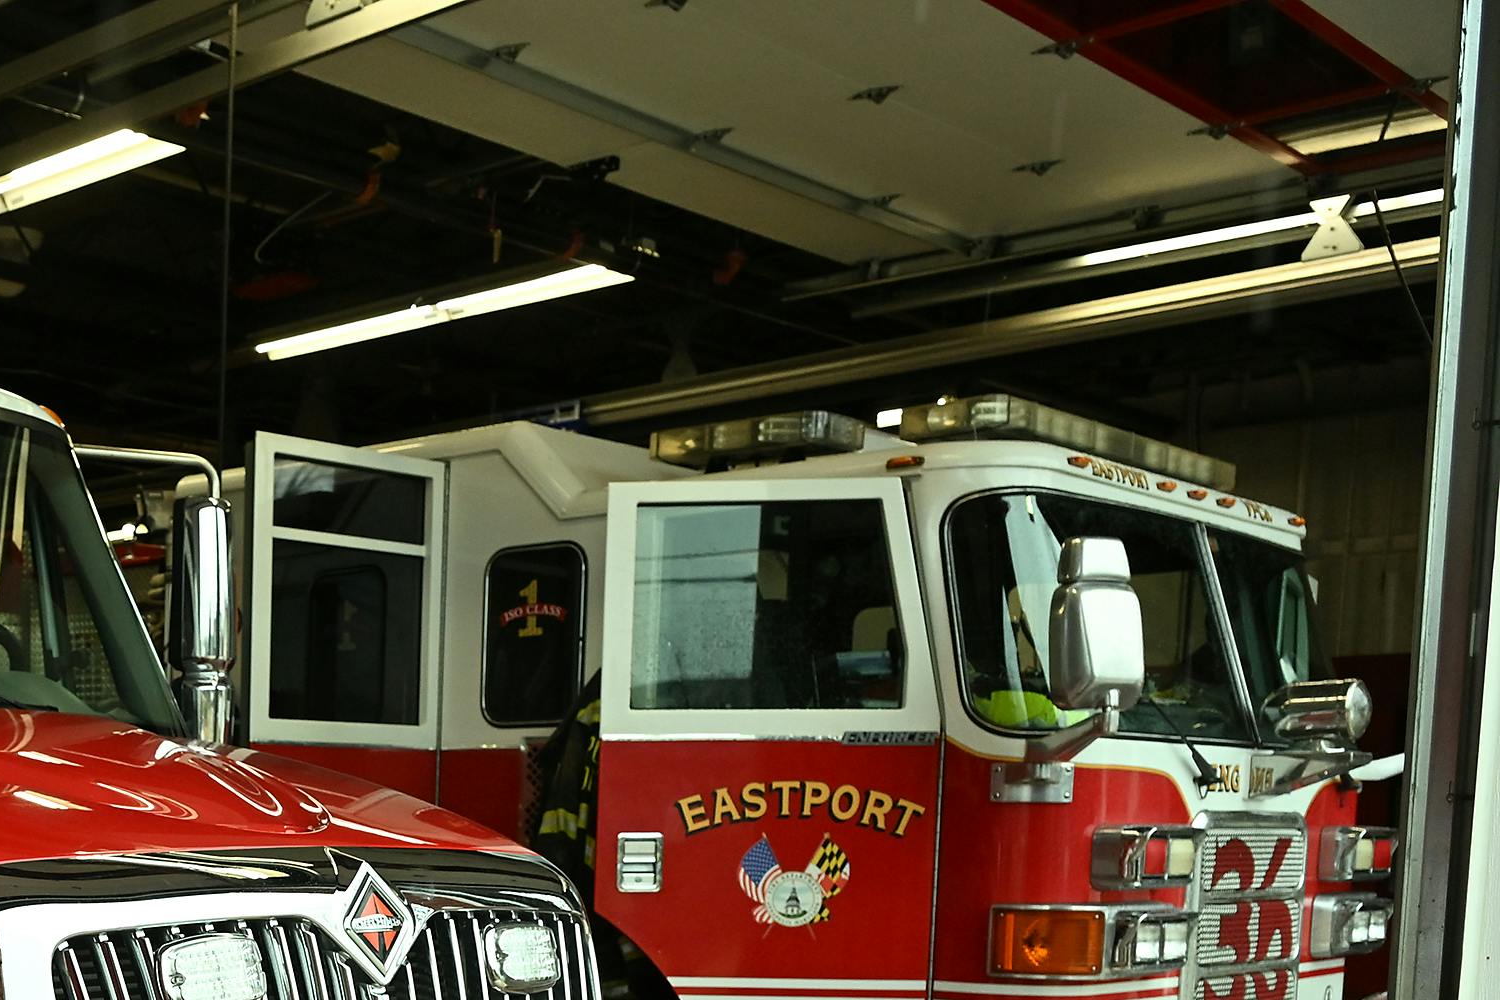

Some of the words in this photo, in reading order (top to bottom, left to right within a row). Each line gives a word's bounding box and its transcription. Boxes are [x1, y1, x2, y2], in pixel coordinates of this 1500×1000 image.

[503, 606, 524, 622] ISO
[526, 604, 563, 618] CLASS
[676, 779, 926, 837] EASTPORT
